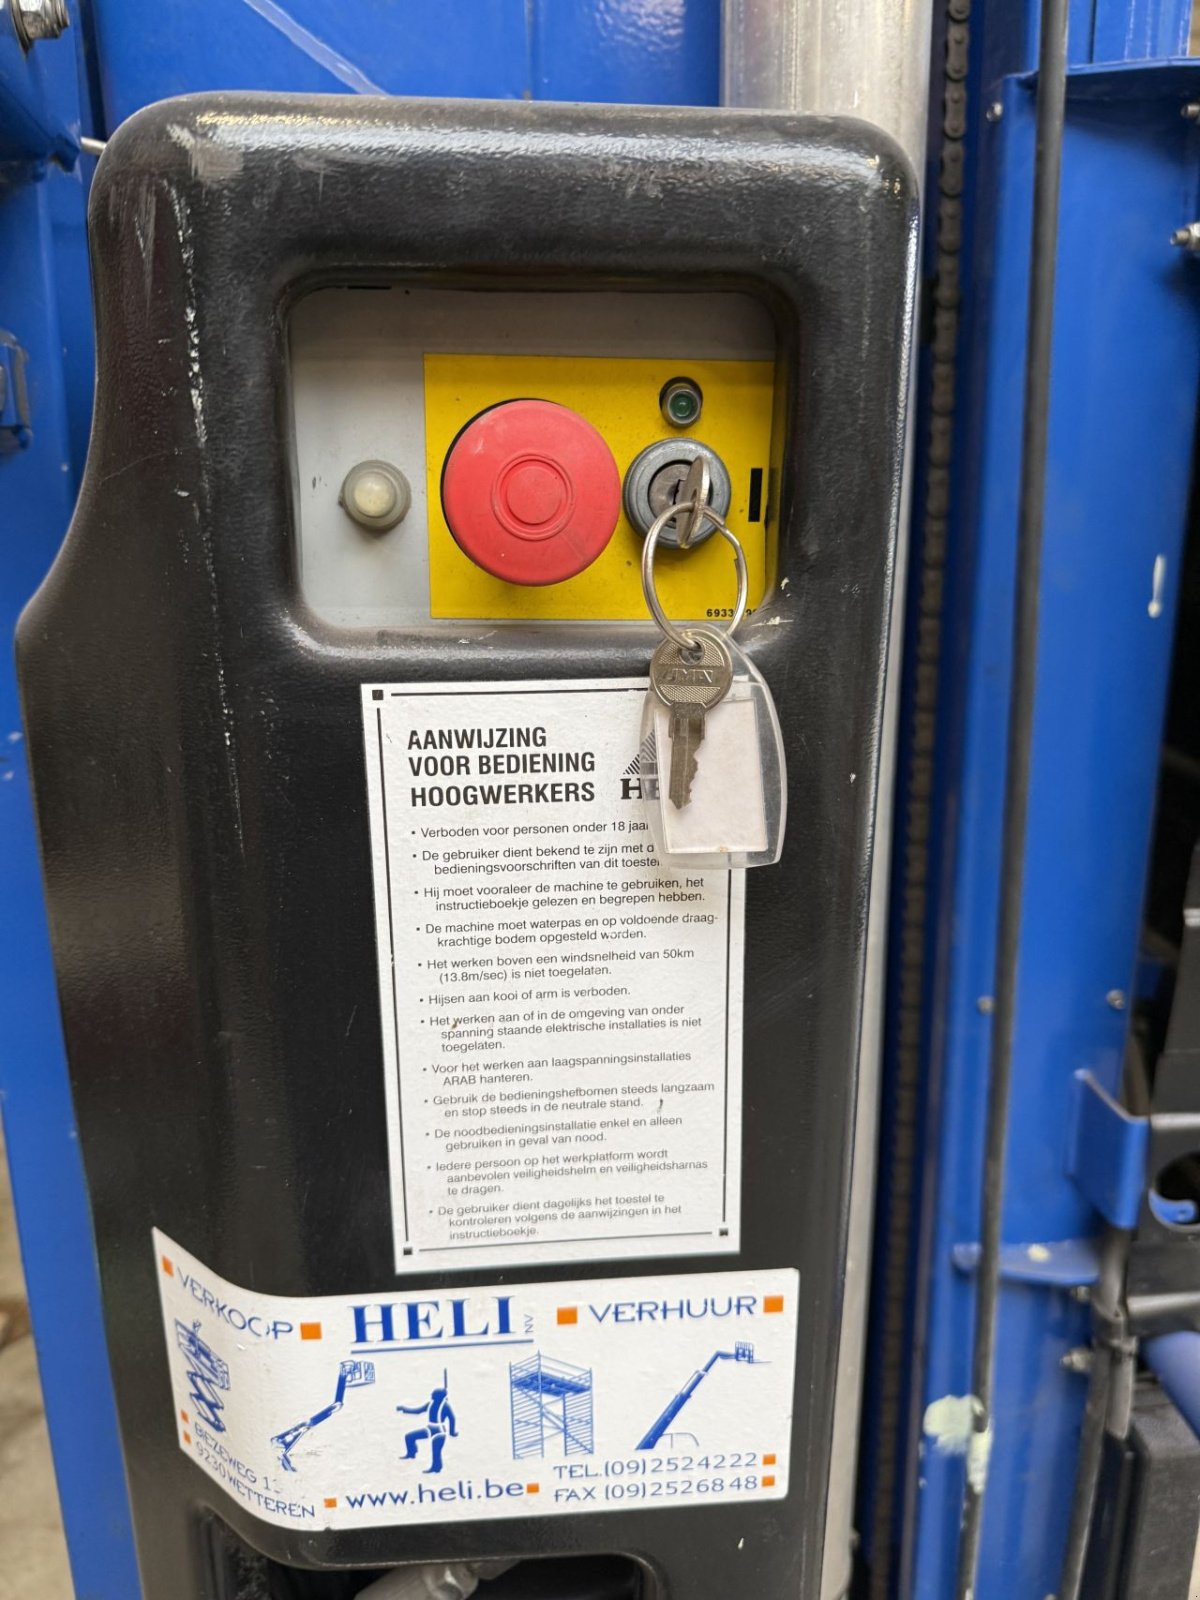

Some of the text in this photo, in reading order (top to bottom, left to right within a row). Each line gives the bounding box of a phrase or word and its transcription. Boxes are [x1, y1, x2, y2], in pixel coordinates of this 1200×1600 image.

[407, 727, 546, 749] AANWIJZING
[408, 752, 595, 776] VOOR BEDIENING
[410, 782, 595, 806] HOOGWERKERS
[420, 826, 479, 838] Verboden
[482, 826, 509, 836] voor
[513, 825, 569, 836] personen
[572, 822, 607, 833] onder
[611, 820, 625, 832] 18
[422, 850, 439, 861] De
[442, 848, 500, 863] gebruiker
[502, 847, 533, 858] dient
[535, 845, 580, 857] bekend
[583, 845, 595, 855] te
[597, 843, 618, 857] zijn
[621, 843, 643, 853] met
[434, 860, 576, 875] bedieningsvoorschriften
[579, 860, 600, 869] van
[601, 857, 619, 868] dit
[423, 877, 704, 900] Hij moet vooraleer de machine te gebruiken, het
[435, 891, 705, 911] instructieboekje gelezen en begrepen hebben.
[425, 913, 718, 934] De machine moet waterpas en op voldoende draag-
[437, 929, 646, 947] krachtige bodem opgesteld worden.
[427, 948, 694, 969] Het werken boven een windsnelheid van 50km
[439, 966, 612, 984] (13.8m/sec) is niet toegelaten.
[428, 986, 630, 1006] Hijsen aan kooi of arm is verboden.
[429, 1005, 685, 1026] Het werken aan of in de omgeving van onder
[440, 1017, 701, 1040] spanning staande elektrische installaties is niet
[441, 1040, 505, 1053] toegelaten.
[431, 1052, 691, 1074] Voor het werken aan laagspanningsinstallaties
[442, 1073, 533, 1086] ARAB hanteren.
[432, 1083, 715, 1105] Gebruik de bedieningshefbomen steeds langzaam
[444, 1097, 643, 1118] en stop steeds in de neutrale stand.
[434, 1116, 682, 1139] De noodbedieningsinstallatie enkel en alleen
[445, 1131, 607, 1153] gebruiken in geval van nood.
[435, 1149, 668, 1171] Iedere persoon op het werkplatform wordt
[446, 1170, 510, 1183] aanbevolen
[512, 1165, 597, 1179] veiligheidshelm
[599, 1165, 613, 1175] en
[447, 1184, 504, 1196] te dragen.
[437, 1206, 454, 1216] De
[456, 1202, 510, 1217] gebruiker
[512, 1201, 541, 1211] dient
[594, 1196, 612, 1206] het
[615, 1194, 651, 1205] toestel
[654, 1194, 665, 1203] te
[448, 1205, 682, 1226] kontroleren volgens de aanwijzingen in het
[449, 1226, 539, 1240] instructieboekje.
[176, 1266, 294, 1340] VERKOOP
[588, 1295, 757, 1323] VERHUUR
[347, 1295, 514, 1344] HELI
[227, 1469, 315, 1518] WETTEREN
[345, 1478, 525, 1509] www.heli.be
[554, 1486, 596, 1503] FAX
